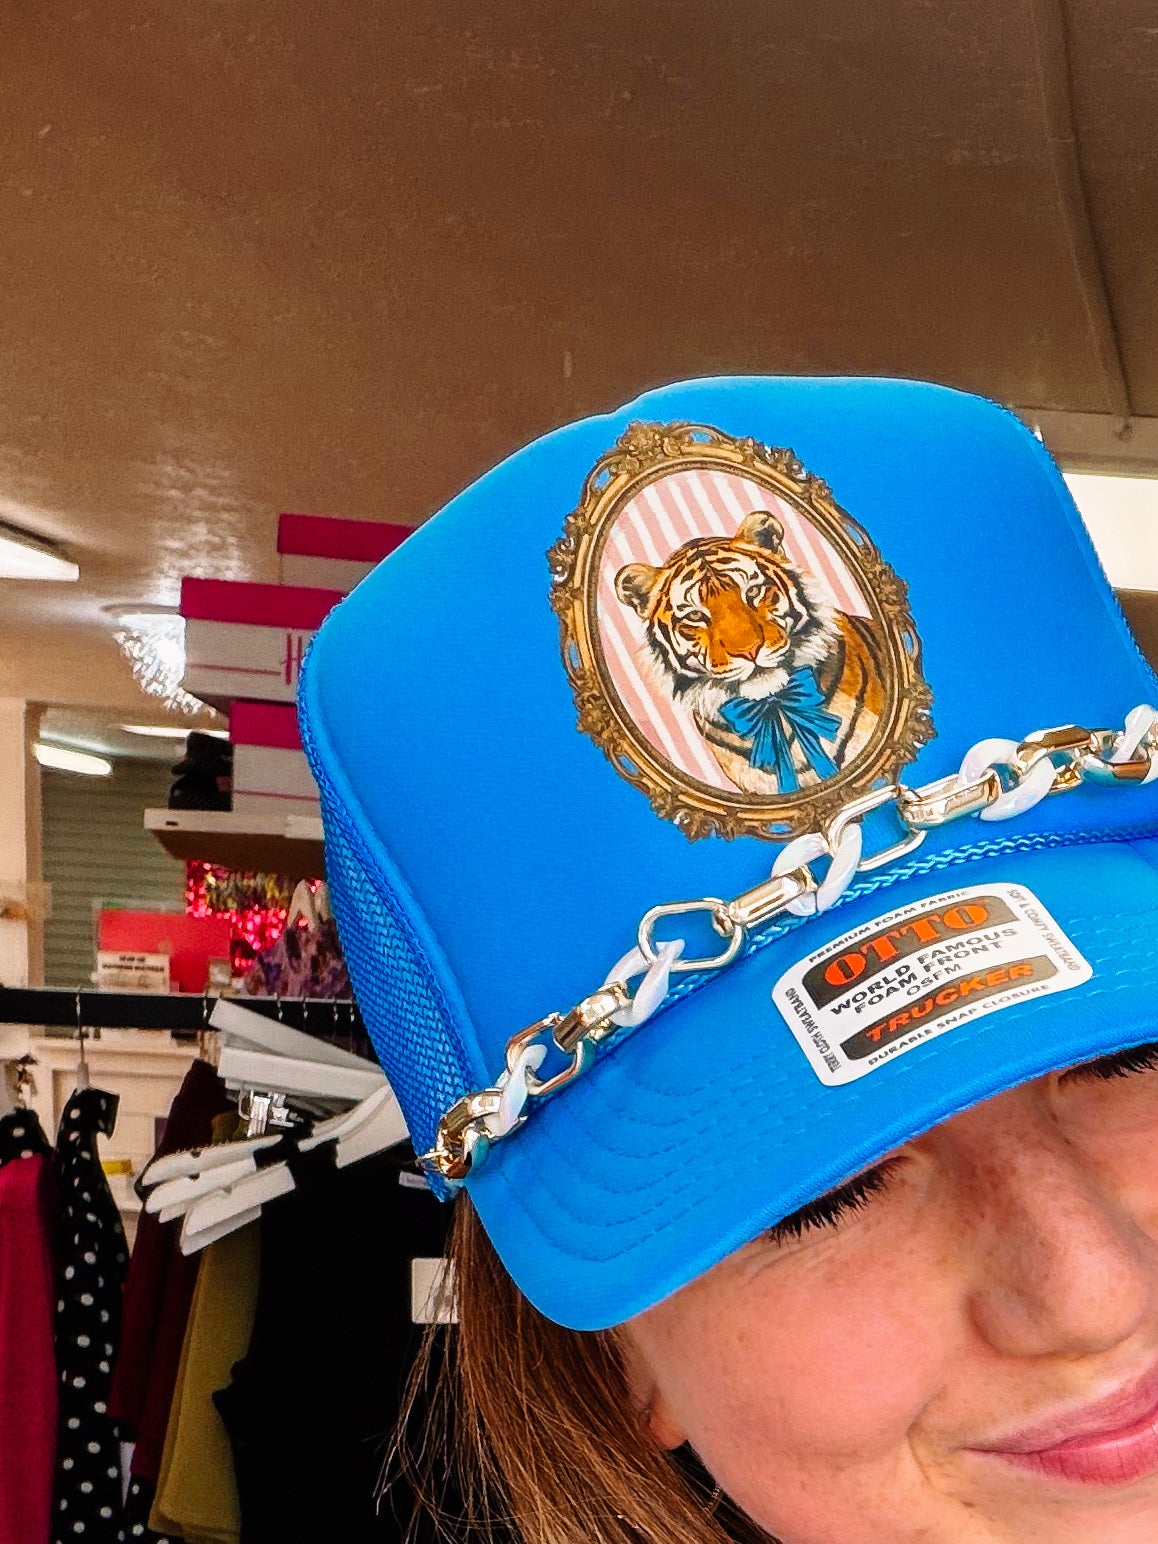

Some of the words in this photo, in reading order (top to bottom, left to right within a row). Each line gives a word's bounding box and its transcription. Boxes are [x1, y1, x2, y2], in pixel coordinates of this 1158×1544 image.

[809, 927, 870, 963] PREMIUM
[875, 907, 916, 927] FOAM
[921, 890, 968, 908] FABRIC
[823, 903, 989, 986] OTTO
[830, 964, 911, 1015] WORLD
[916, 928, 1017, 964] FAMOUS
[854, 972, 918, 1014] FOAM
[923, 940, 1005, 973] FRONT
[865, 962, 1034, 1042] TRUCKER
[906, 964, 962, 996] OSFM
[868, 1028, 933, 1066] DURABLE
[936, 1008, 977, 1029] SNAP
[982, 984, 1050, 1010] CLOSURE
